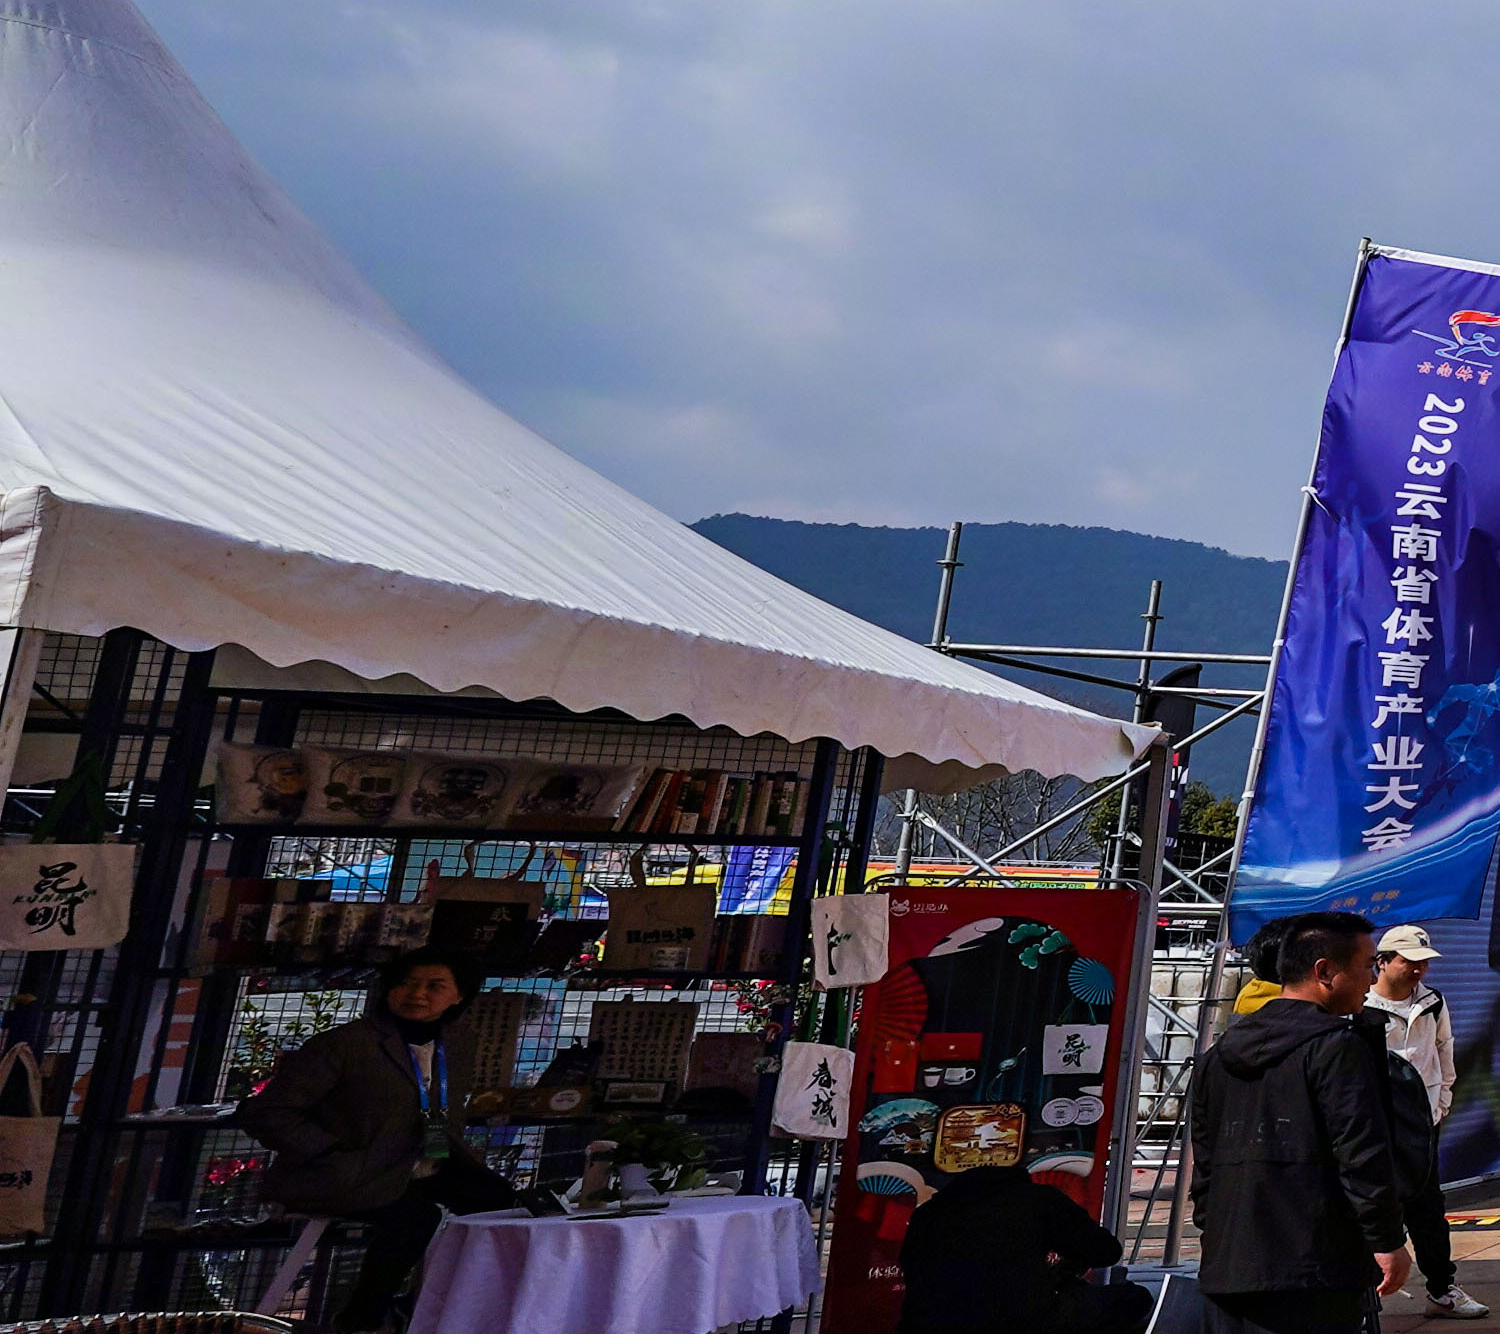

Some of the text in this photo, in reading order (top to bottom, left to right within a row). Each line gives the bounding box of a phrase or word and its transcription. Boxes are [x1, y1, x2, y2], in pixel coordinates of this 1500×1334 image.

[1361, 392, 1466, 854] 2023云南省体育产业大会
